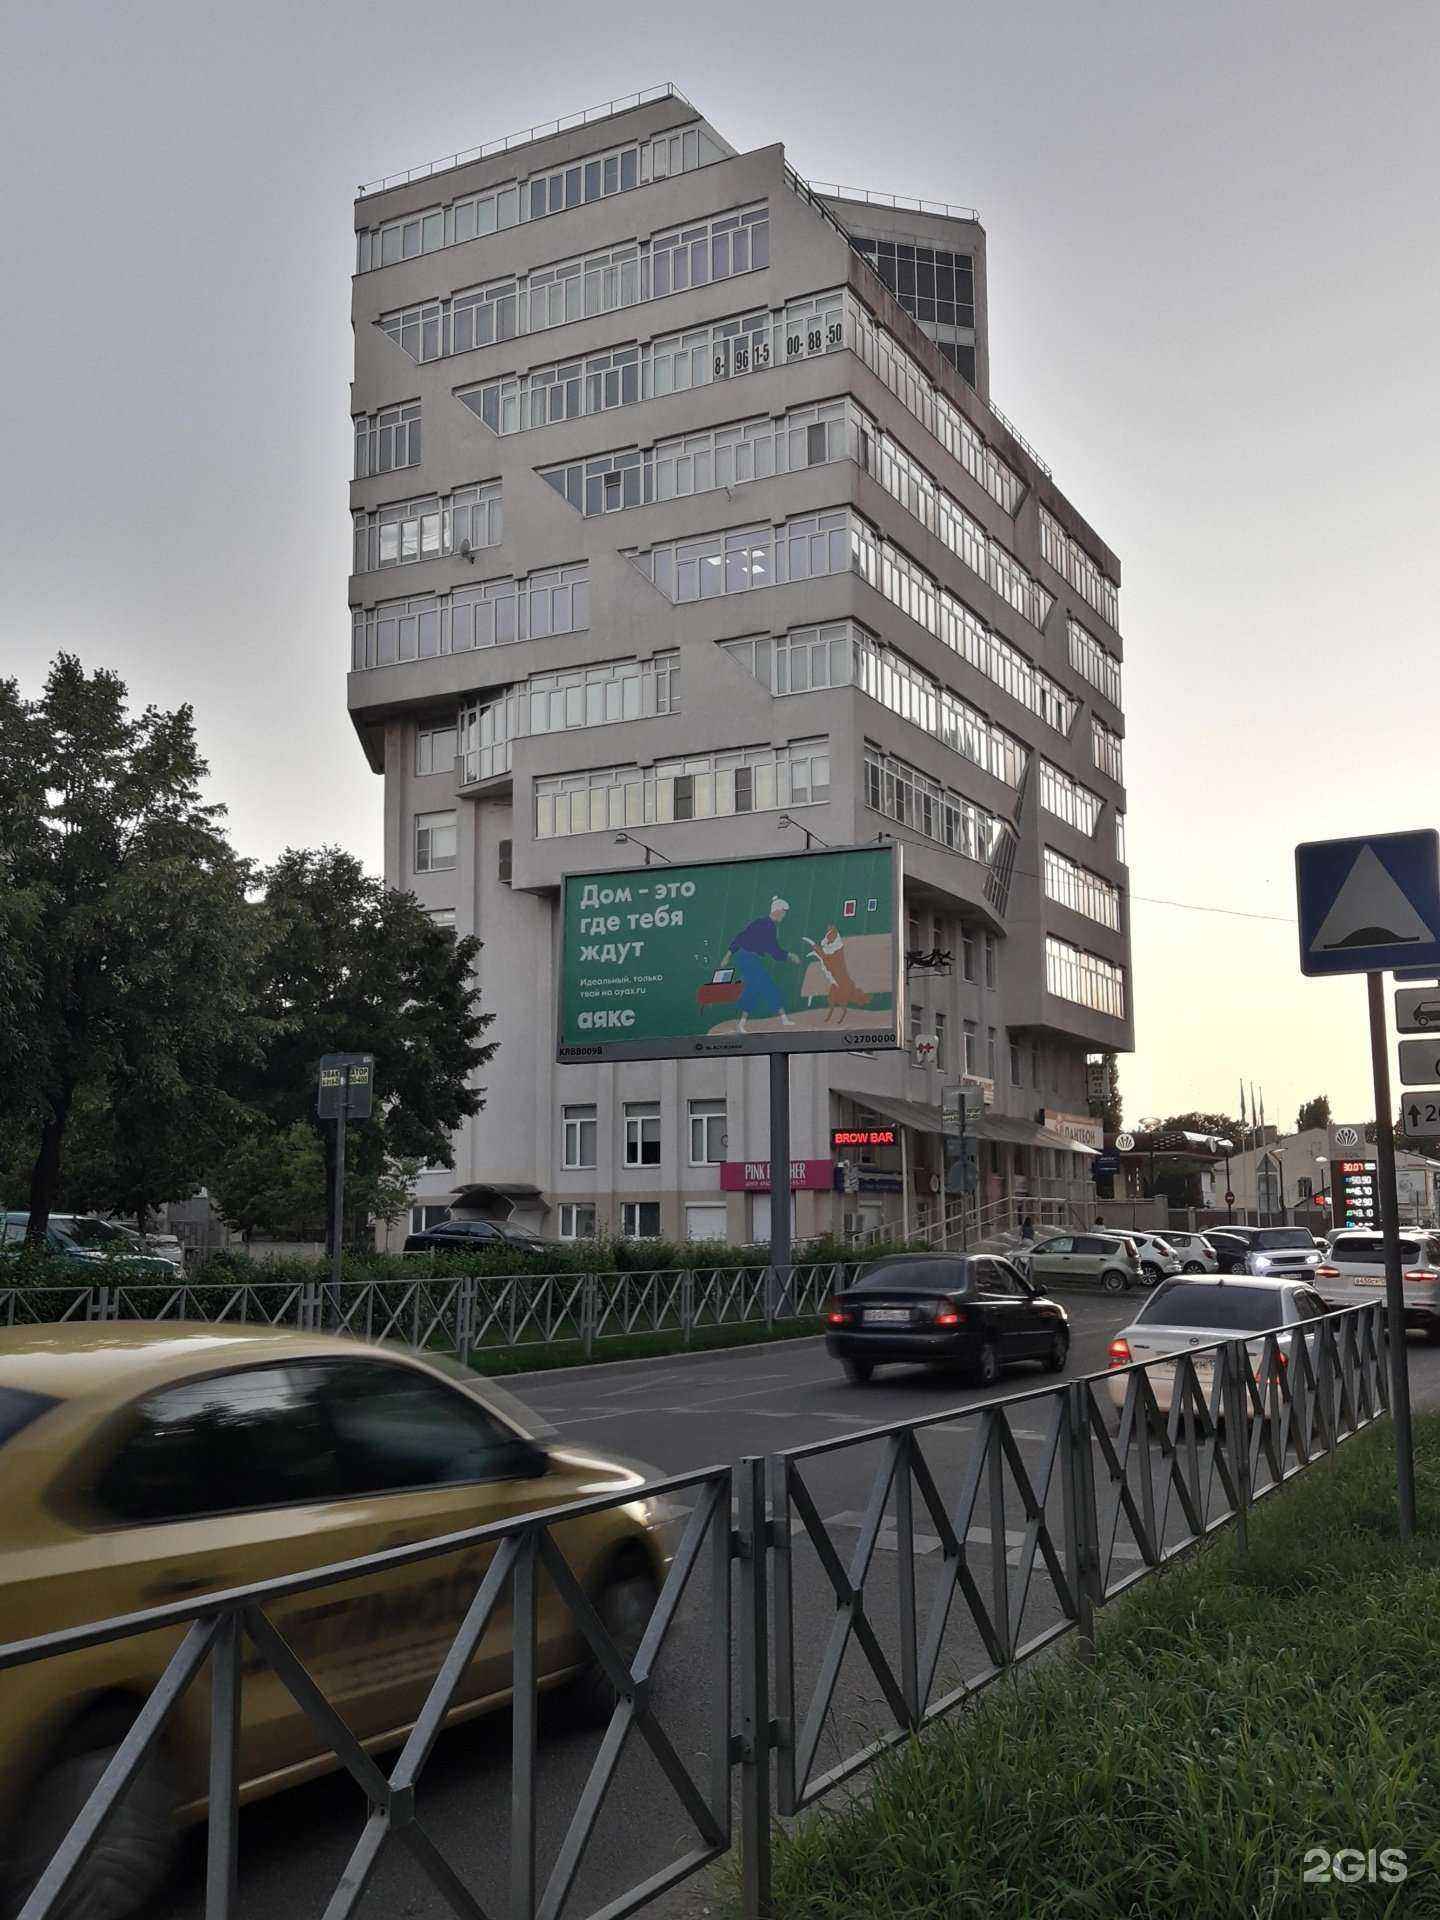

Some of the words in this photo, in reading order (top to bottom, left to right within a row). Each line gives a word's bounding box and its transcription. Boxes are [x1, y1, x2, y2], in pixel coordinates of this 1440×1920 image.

[580, 884, 632, 910] Дом
[655, 881, 696, 900] это
[580, 915, 620, 936] где
[627, 904, 683, 930] тебя
[579, 941, 645, 964] ждут
[633, 974, 663, 983] только
[577, 1009, 636, 1029] аякс
[854, 1033, 896, 1044] 2700000
[835, 1132, 869, 1144] BROW
[870, 1131, 894, 1143] BAR
[745, 1162, 766, 1181] PINK
